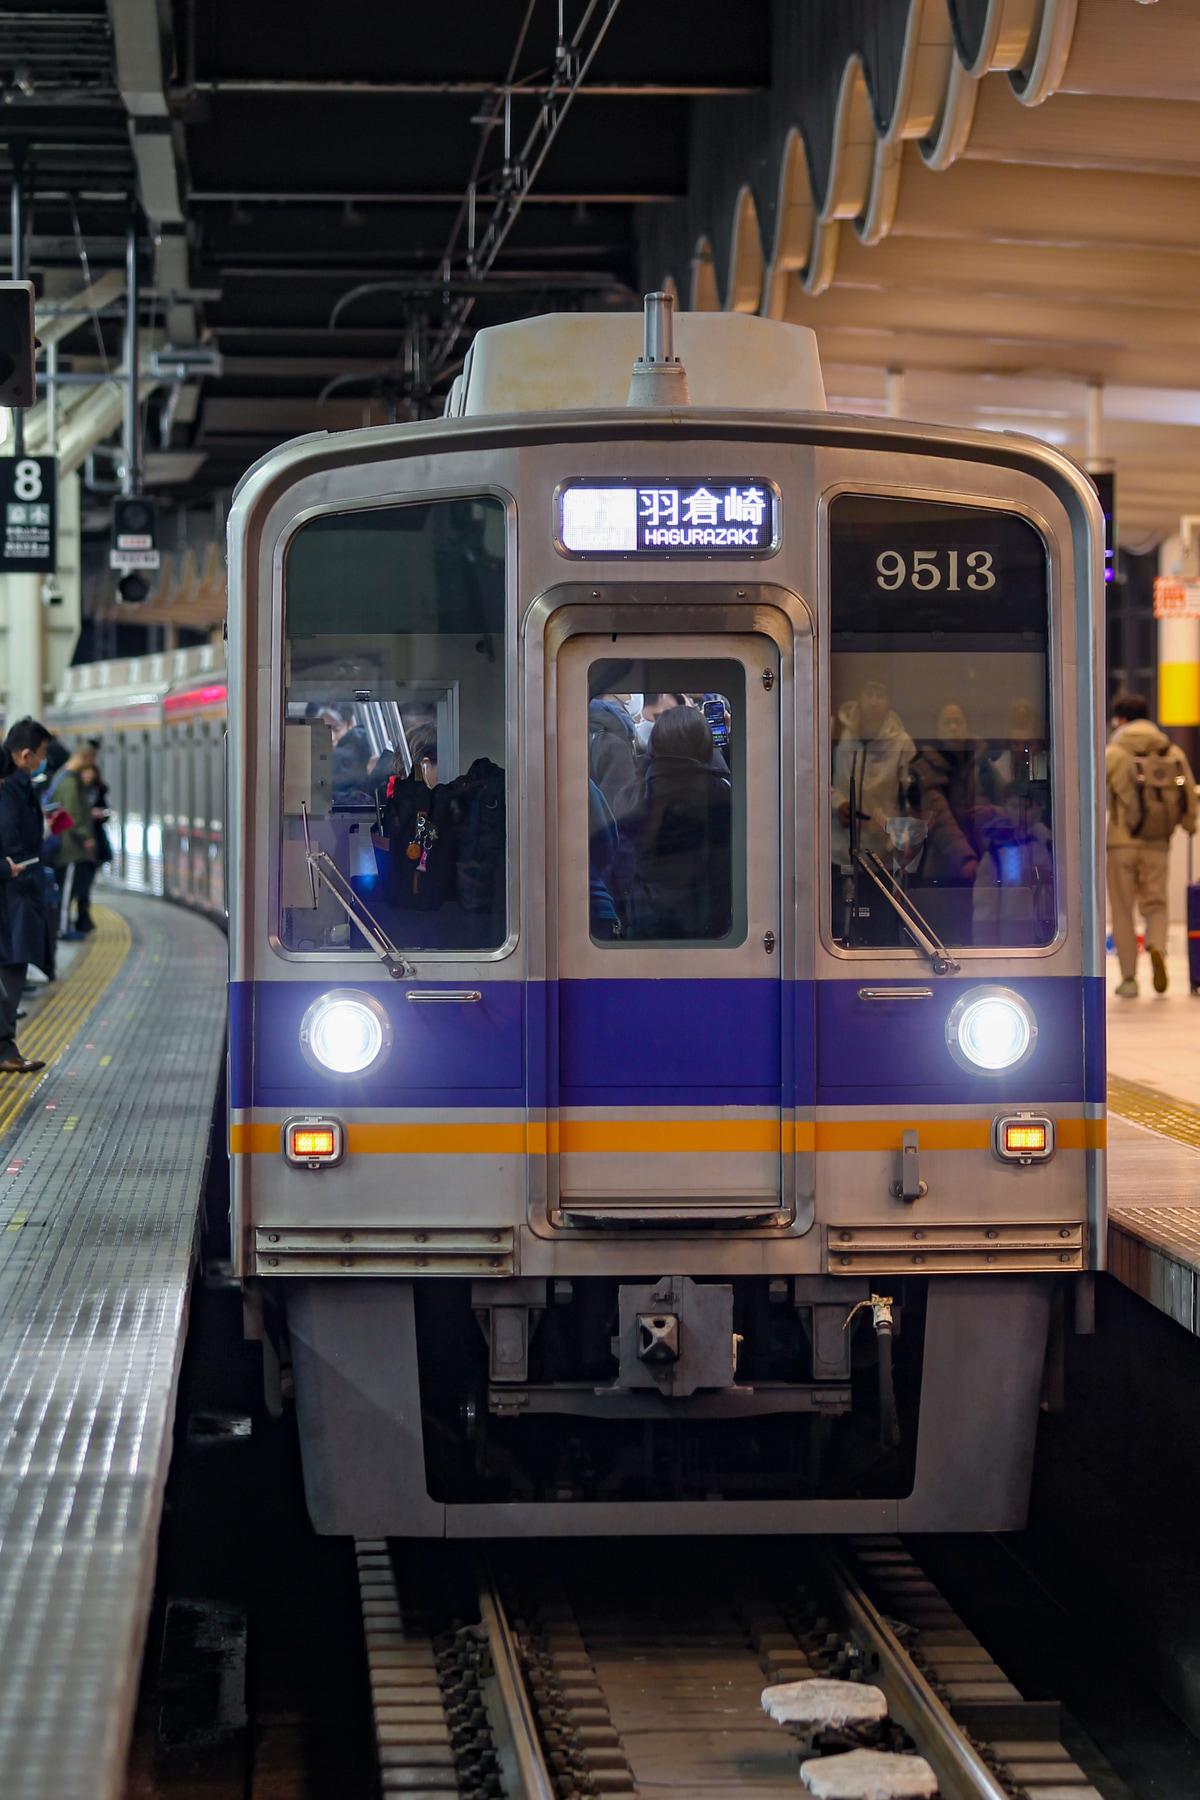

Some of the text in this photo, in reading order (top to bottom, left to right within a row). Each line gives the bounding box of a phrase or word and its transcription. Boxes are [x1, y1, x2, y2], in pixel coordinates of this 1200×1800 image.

[14, 459, 43, 501] 8
[639, 488, 766, 526] 羽倉崎
[644, 528, 759, 545] HAGURAZAKI
[875, 550, 997, 591] 9513
